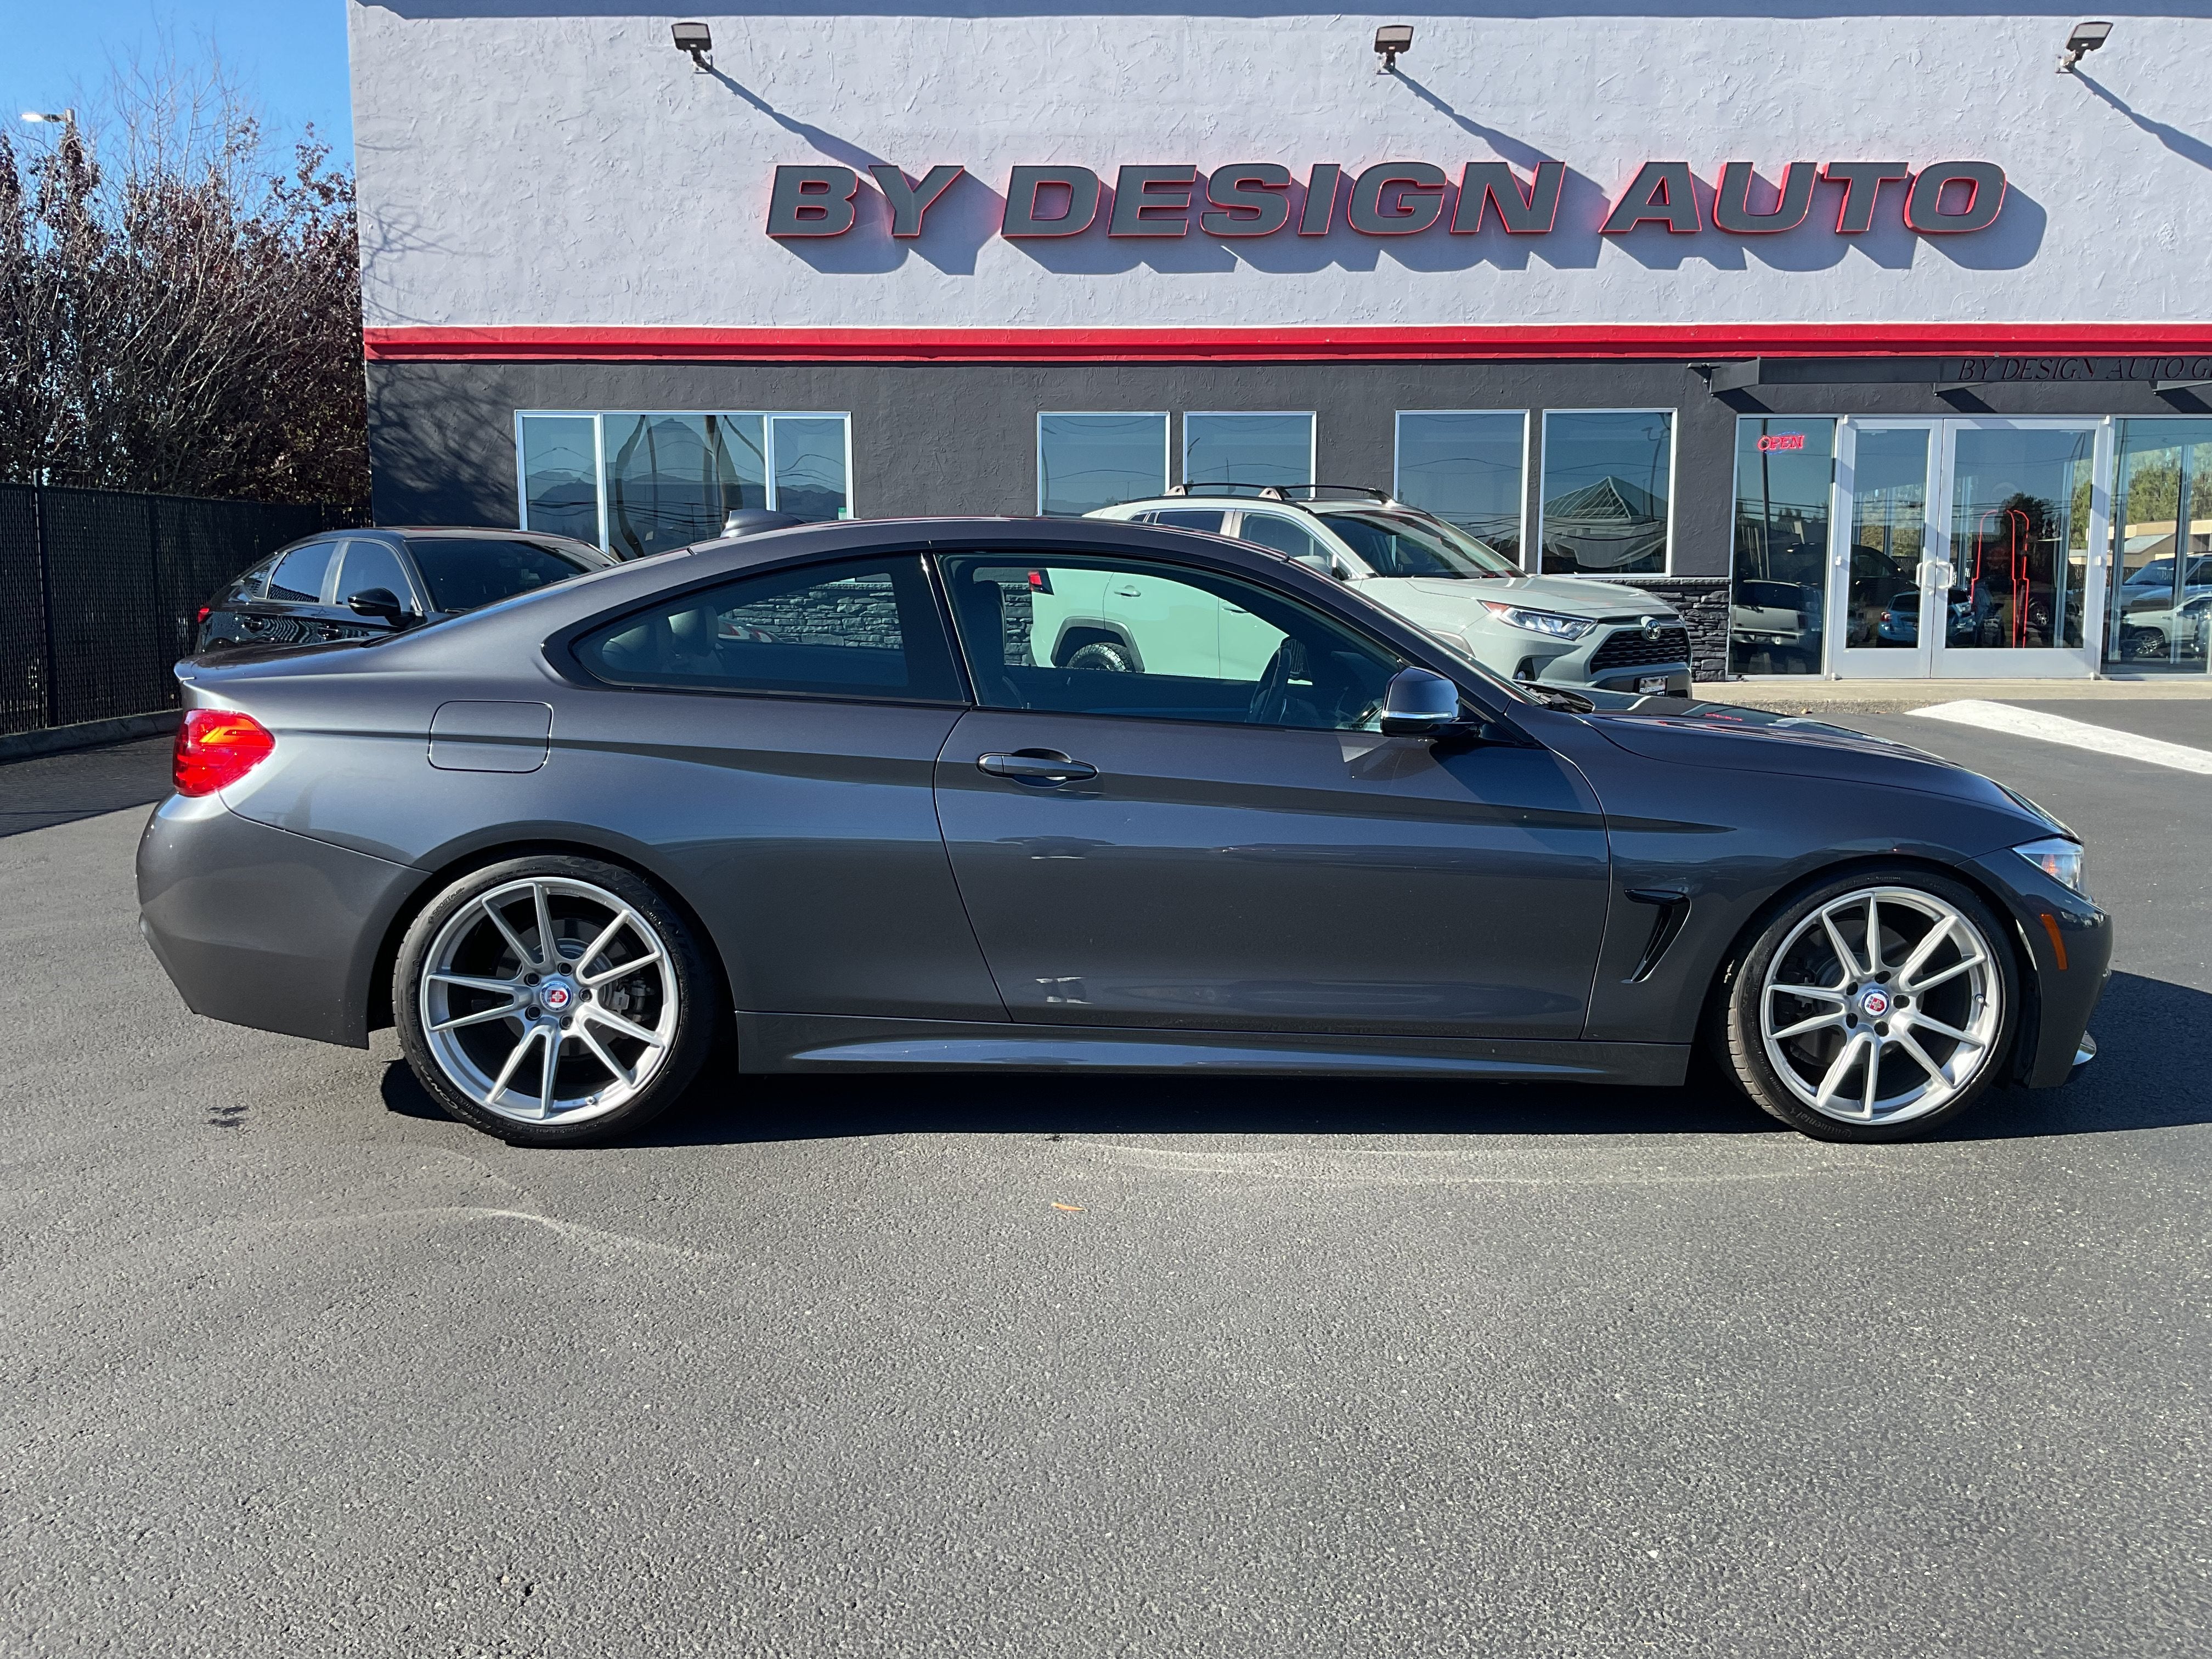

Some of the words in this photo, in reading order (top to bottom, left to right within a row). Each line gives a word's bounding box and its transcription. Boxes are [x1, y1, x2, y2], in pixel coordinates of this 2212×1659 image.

[766, 164, 964, 238] BY
[1001, 162, 1566, 238] DESIGN
[1599, 161, 2007, 235] AUTO
[1958, 358, 1993, 380] BY
[2001, 358, 2100, 380] DESIGN
[2108, 357, 2185, 380] AUTO
[2192, 357, 2212, 379] G
[1757, 435, 1805, 450] OPEN
